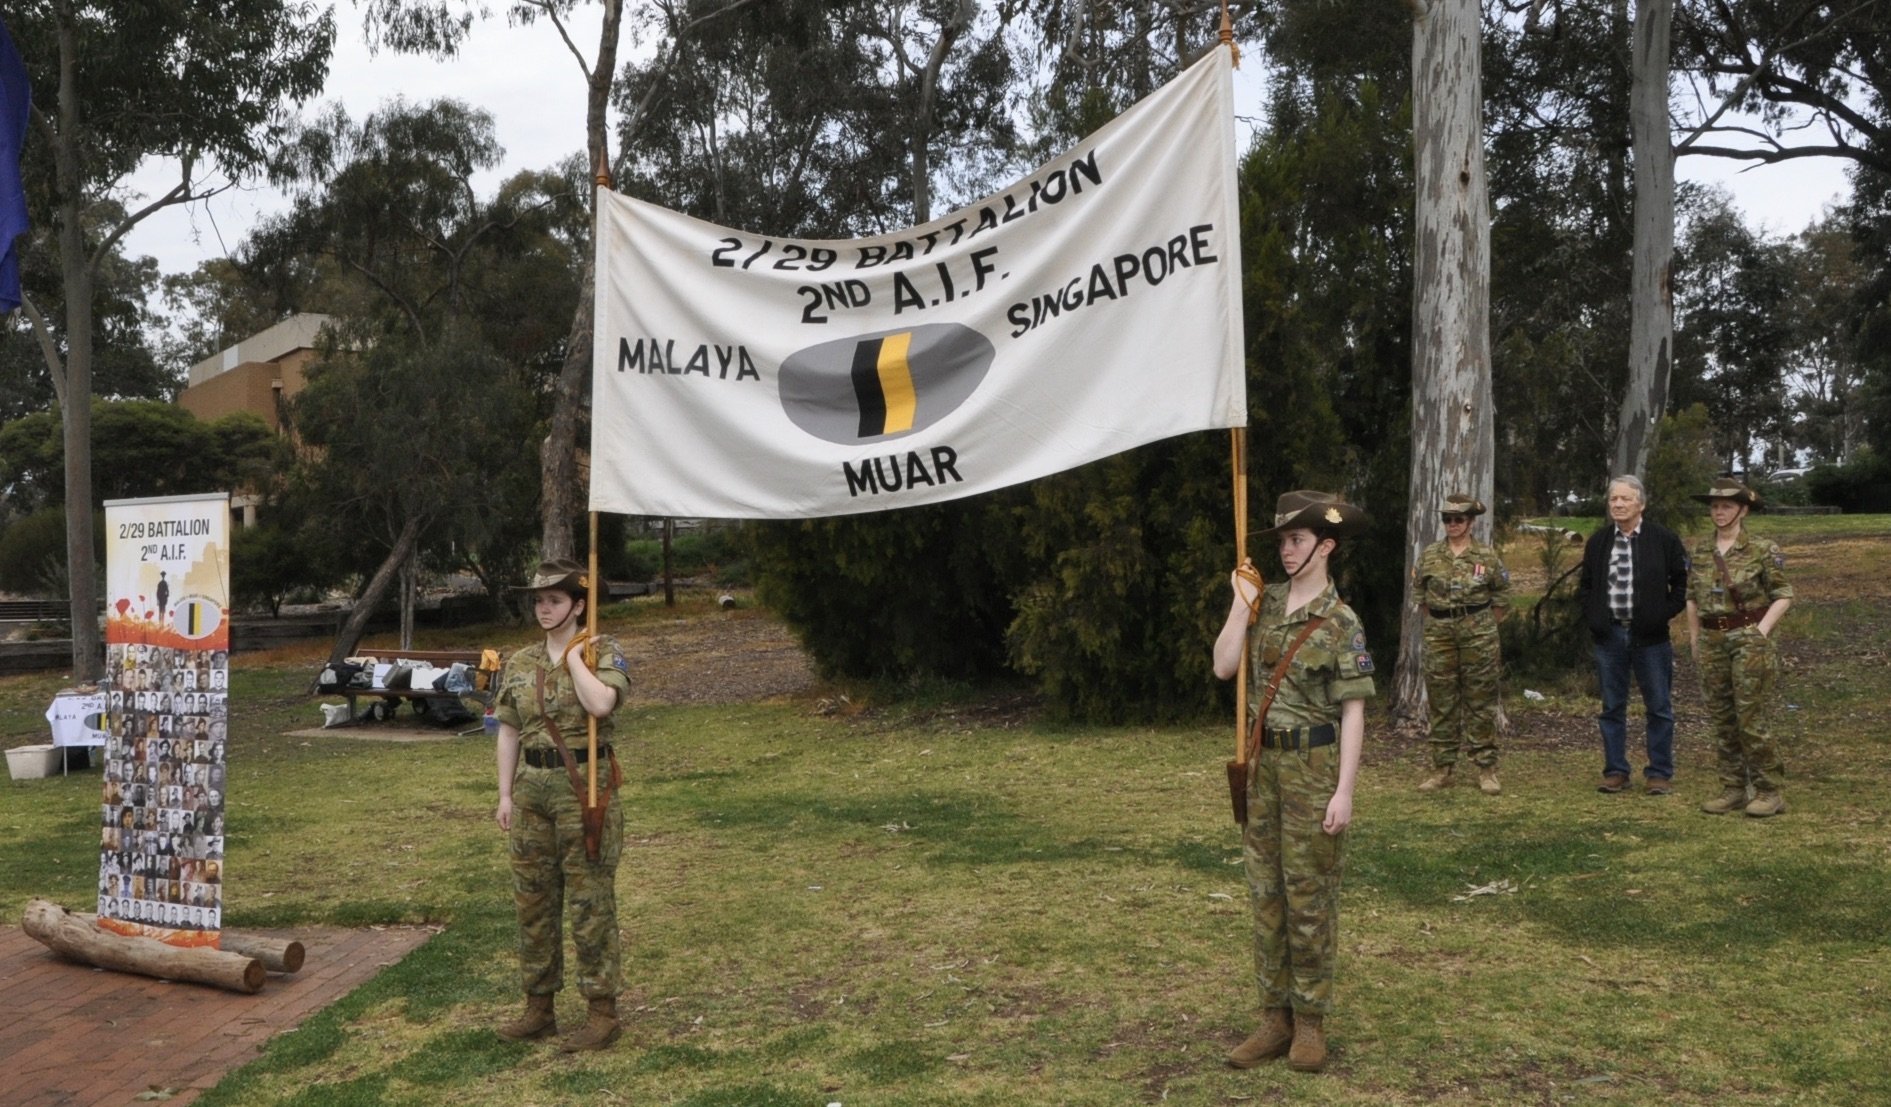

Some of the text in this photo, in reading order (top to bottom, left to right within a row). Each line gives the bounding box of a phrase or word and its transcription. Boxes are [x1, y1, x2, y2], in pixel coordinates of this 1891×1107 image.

[711, 149, 1103, 272] 2/29 BATTALION
[798, 246, 1010, 324] 2ND A.I.F.
[1006, 223, 1219, 339] SINGAPORE
[617, 336, 761, 382] MALAYA
[843, 446, 963, 498] MUAR
[119, 518, 210, 539] 2/29 BATTALION
[140, 543, 187, 562] 2ND A.I.F.
